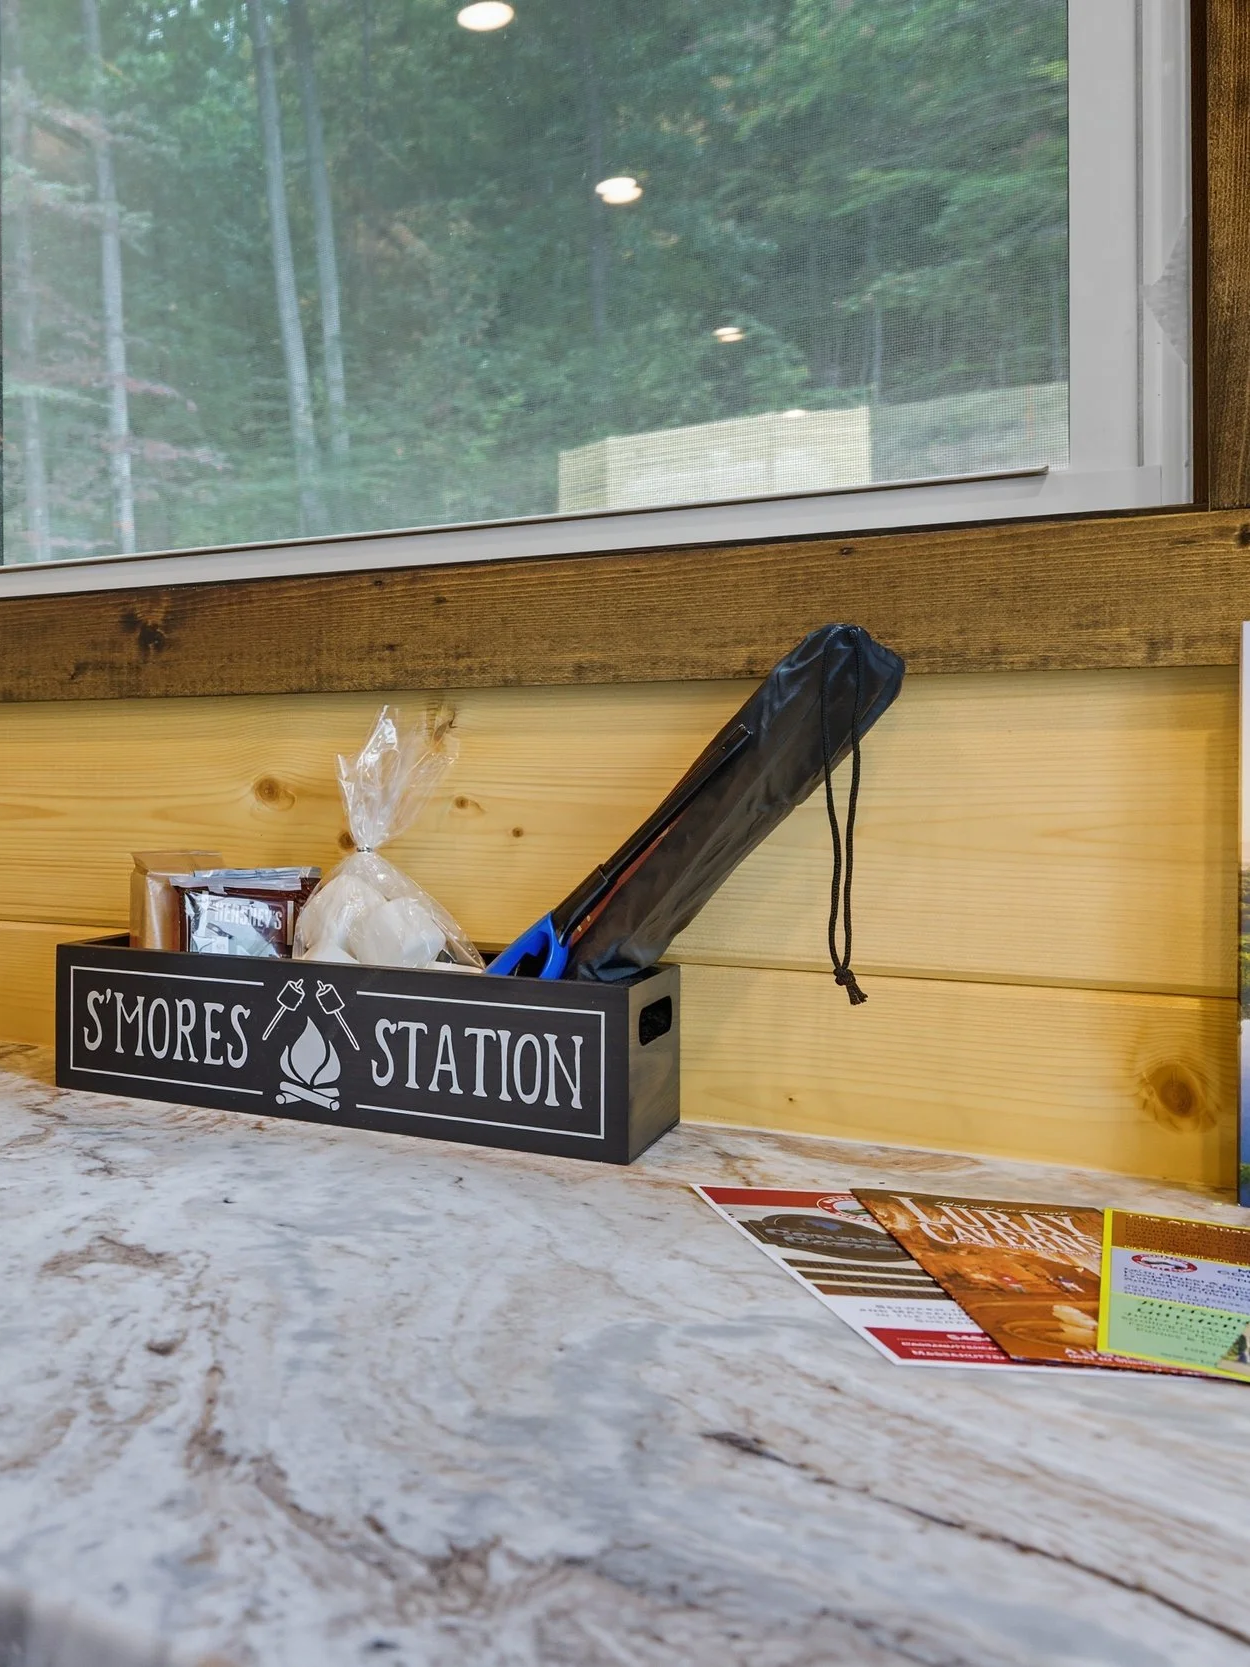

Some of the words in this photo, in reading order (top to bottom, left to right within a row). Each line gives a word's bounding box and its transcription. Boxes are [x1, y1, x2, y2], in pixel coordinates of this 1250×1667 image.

[214, 902, 283, 930] HERSHEY'S
[83, 988, 251, 1068] S'MORES
[370, 1018, 584, 1110] STATION
[889, 1195, 1093, 1238] LURAY
[918, 1222, 1102, 1255] CAVERNS
